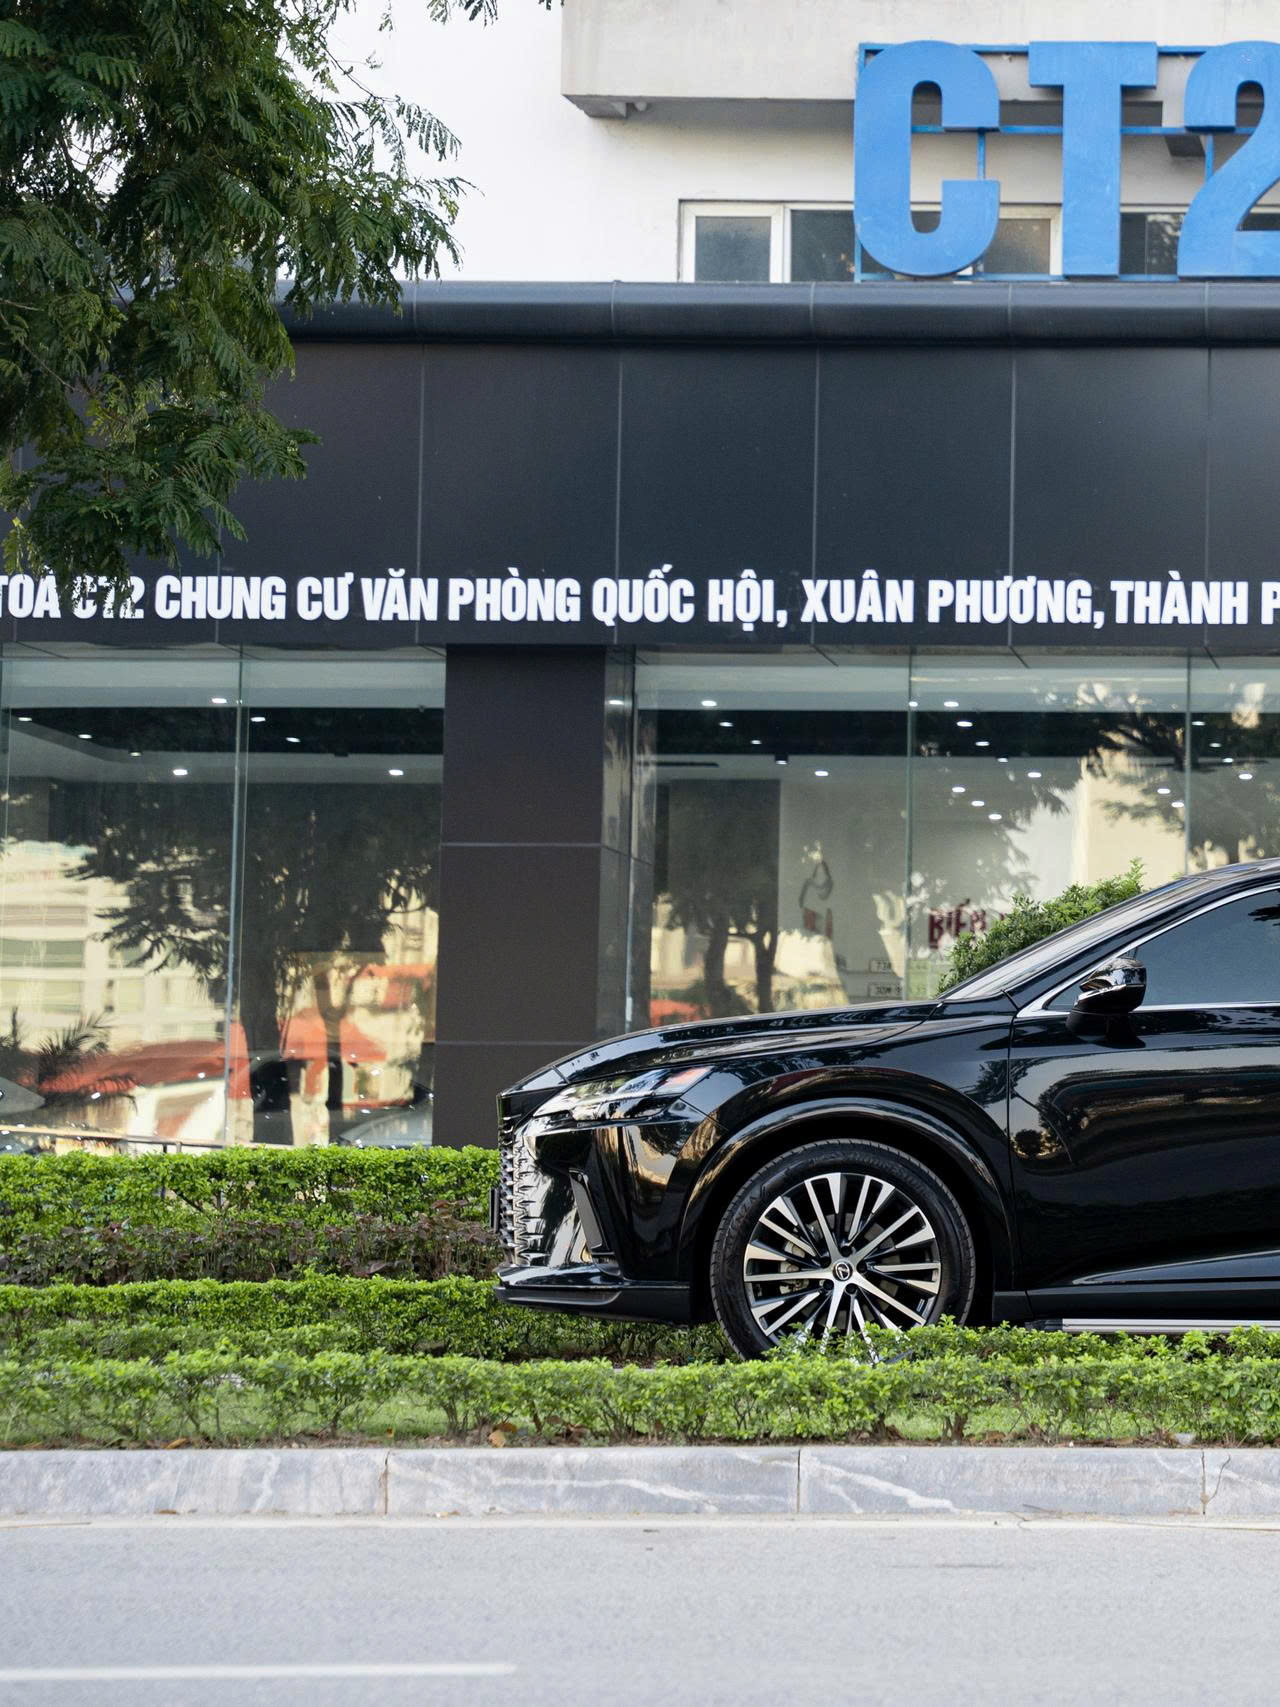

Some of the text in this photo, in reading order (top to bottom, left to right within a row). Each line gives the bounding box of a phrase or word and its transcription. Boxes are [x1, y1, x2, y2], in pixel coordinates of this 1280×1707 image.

[154, 574, 287, 620] CHUNG
[296, 571, 354, 621] CƯ
[360, 567, 439, 621] VĂN
[447, 566, 581, 623] PHÒNG
[591, 563, 695, 627] QUỐC
[707, 568, 788, 632] HỘI,
[800, 569, 915, 624] XUÂN
[927, 575, 1105, 629] PHƯƠNG,
[1110, 570, 1249, 625] THÀNH
